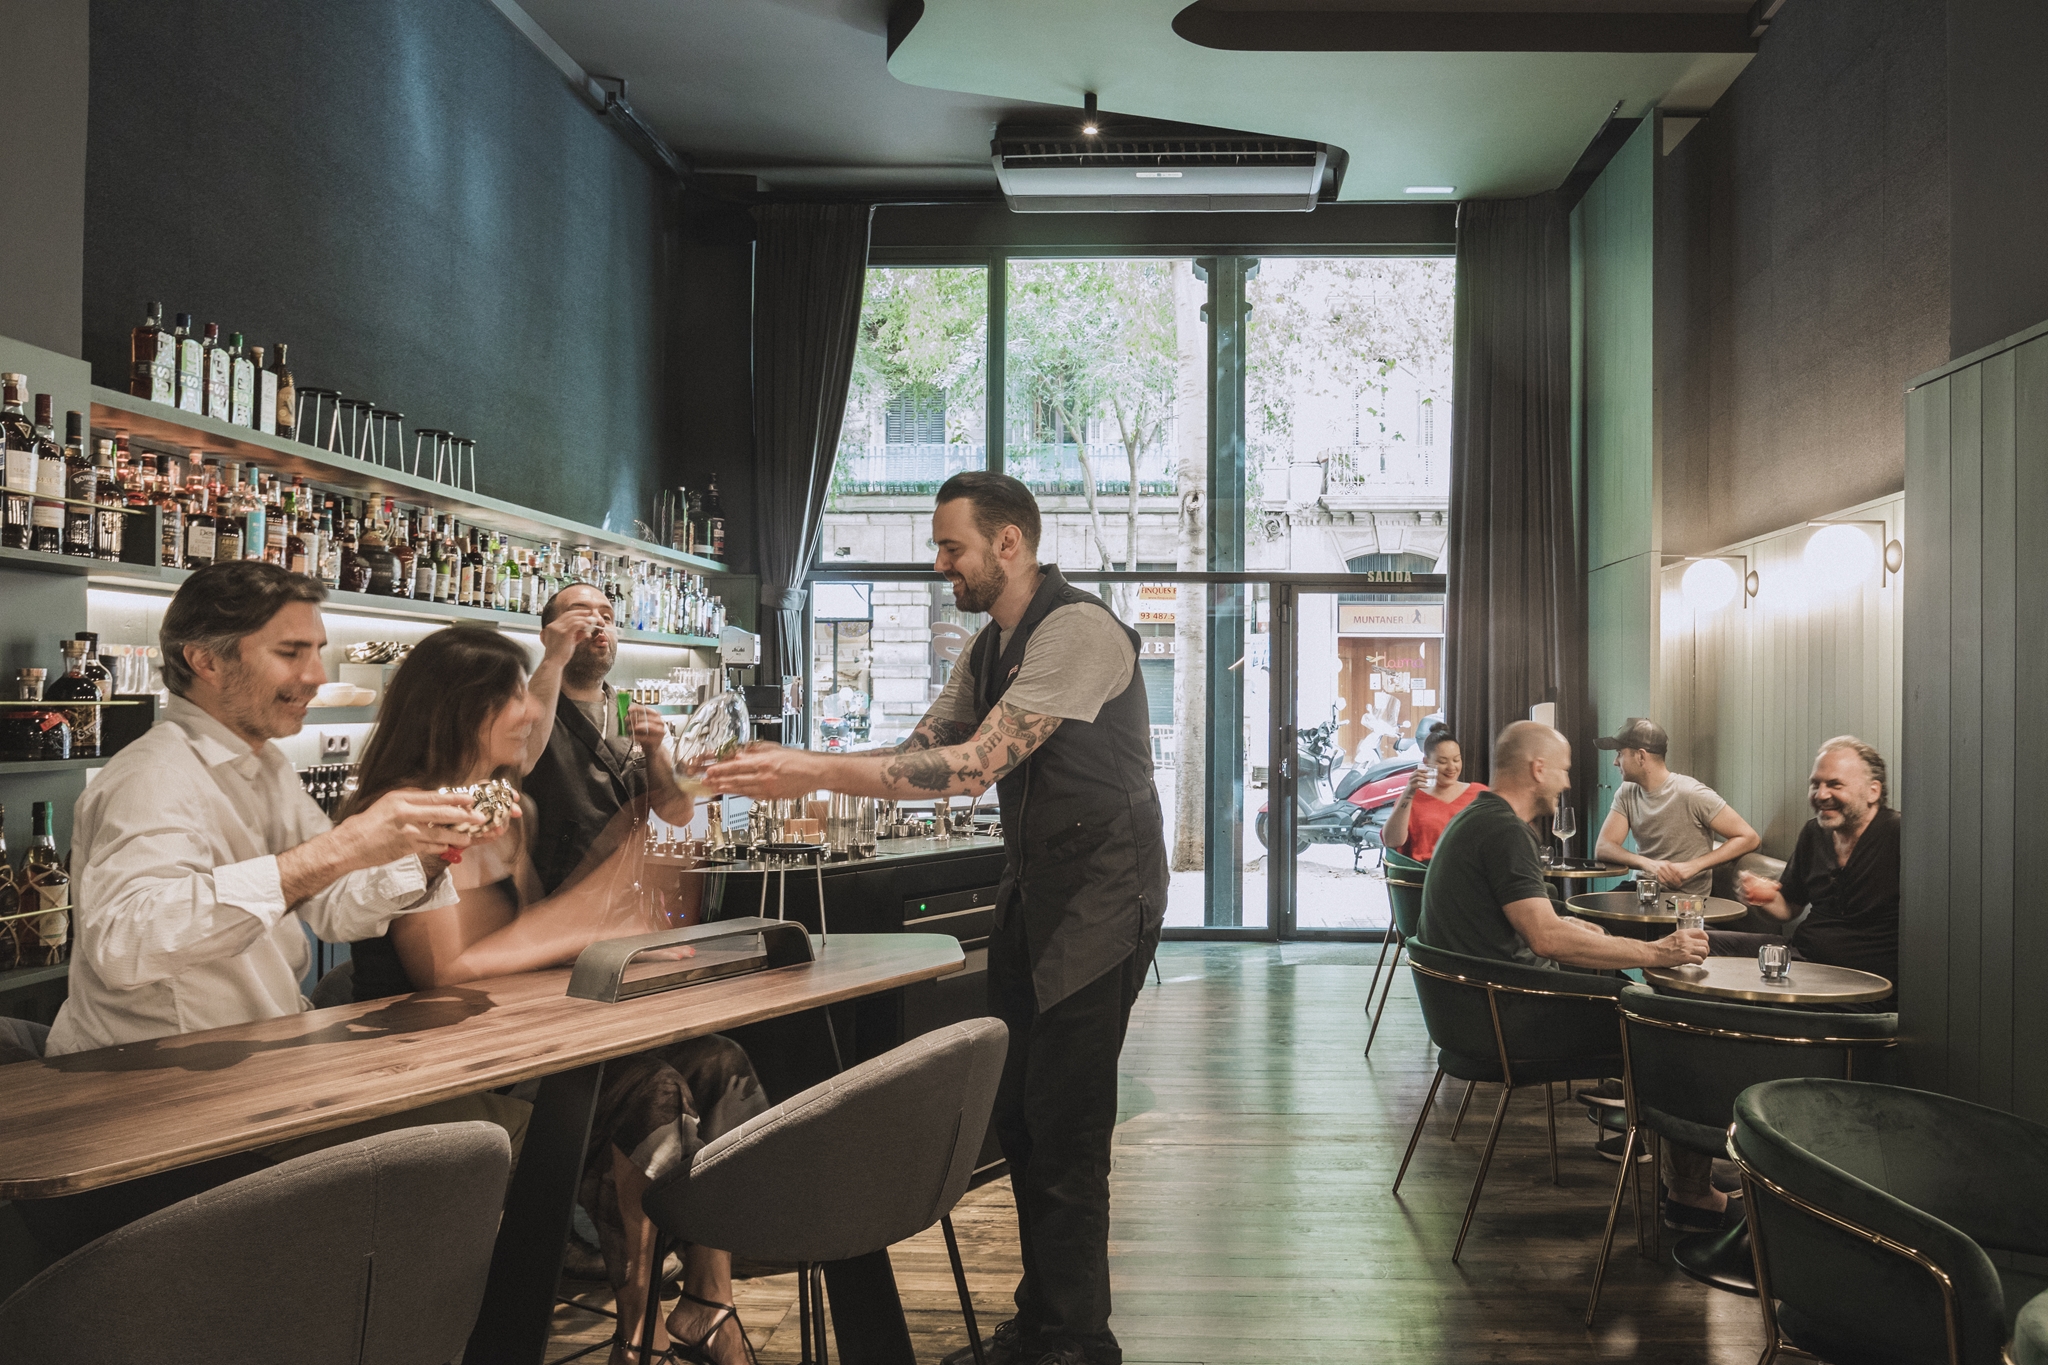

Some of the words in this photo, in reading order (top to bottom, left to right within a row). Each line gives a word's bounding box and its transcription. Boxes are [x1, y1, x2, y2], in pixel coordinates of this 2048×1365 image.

[1367, 570, 1412, 583] SALIDA
[1141, 587, 1172, 595] FINQUES
[1140, 612, 1150, 620] 93
[1353, 615, 1404, 624] MUNTANER
